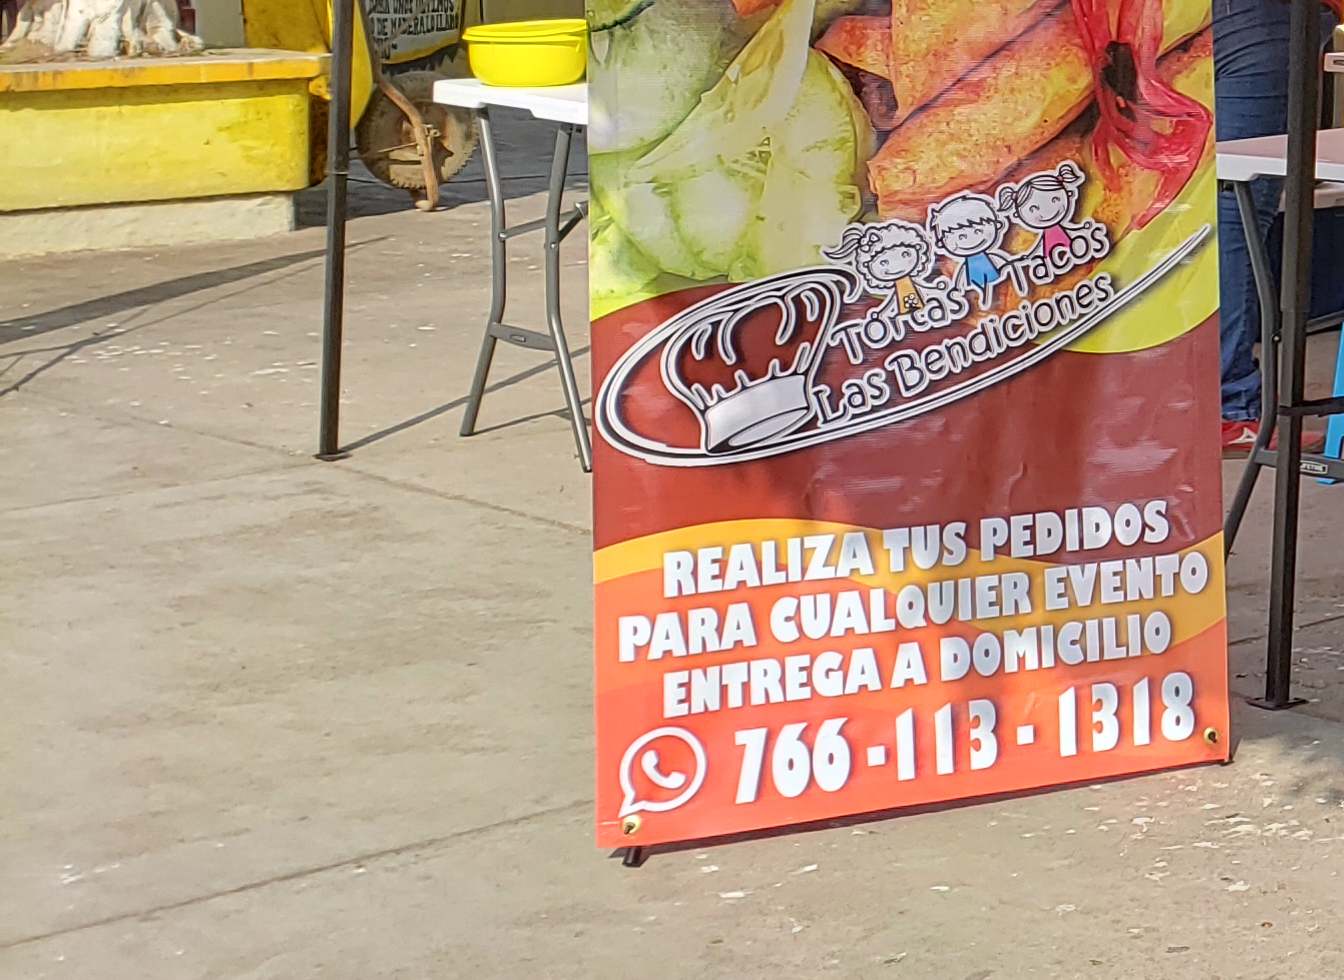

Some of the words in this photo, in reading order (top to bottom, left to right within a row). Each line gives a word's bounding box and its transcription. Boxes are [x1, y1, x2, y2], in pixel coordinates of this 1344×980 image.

[831, 281, 970, 363] Tortas
[972, 267, 996, 310] y
[1002, 221, 1109, 295] Tacos
[814, 366, 891, 424] Las
[891, 273, 1113, 398] Bendiciones
[663, 531, 874, 597] REALIZA
[883, 522, 967, 573] TUS
[980, 500, 1169, 561] PEDIDOS
[618, 602, 757, 662] PARA
[769, 571, 1031, 641] CUALQUIER
[1044, 551, 1208, 610] EVENTO
[663, 648, 881, 718] ENTREGA
[891, 641, 926, 688] A
[940, 611, 1171, 682] DOMICILIO
